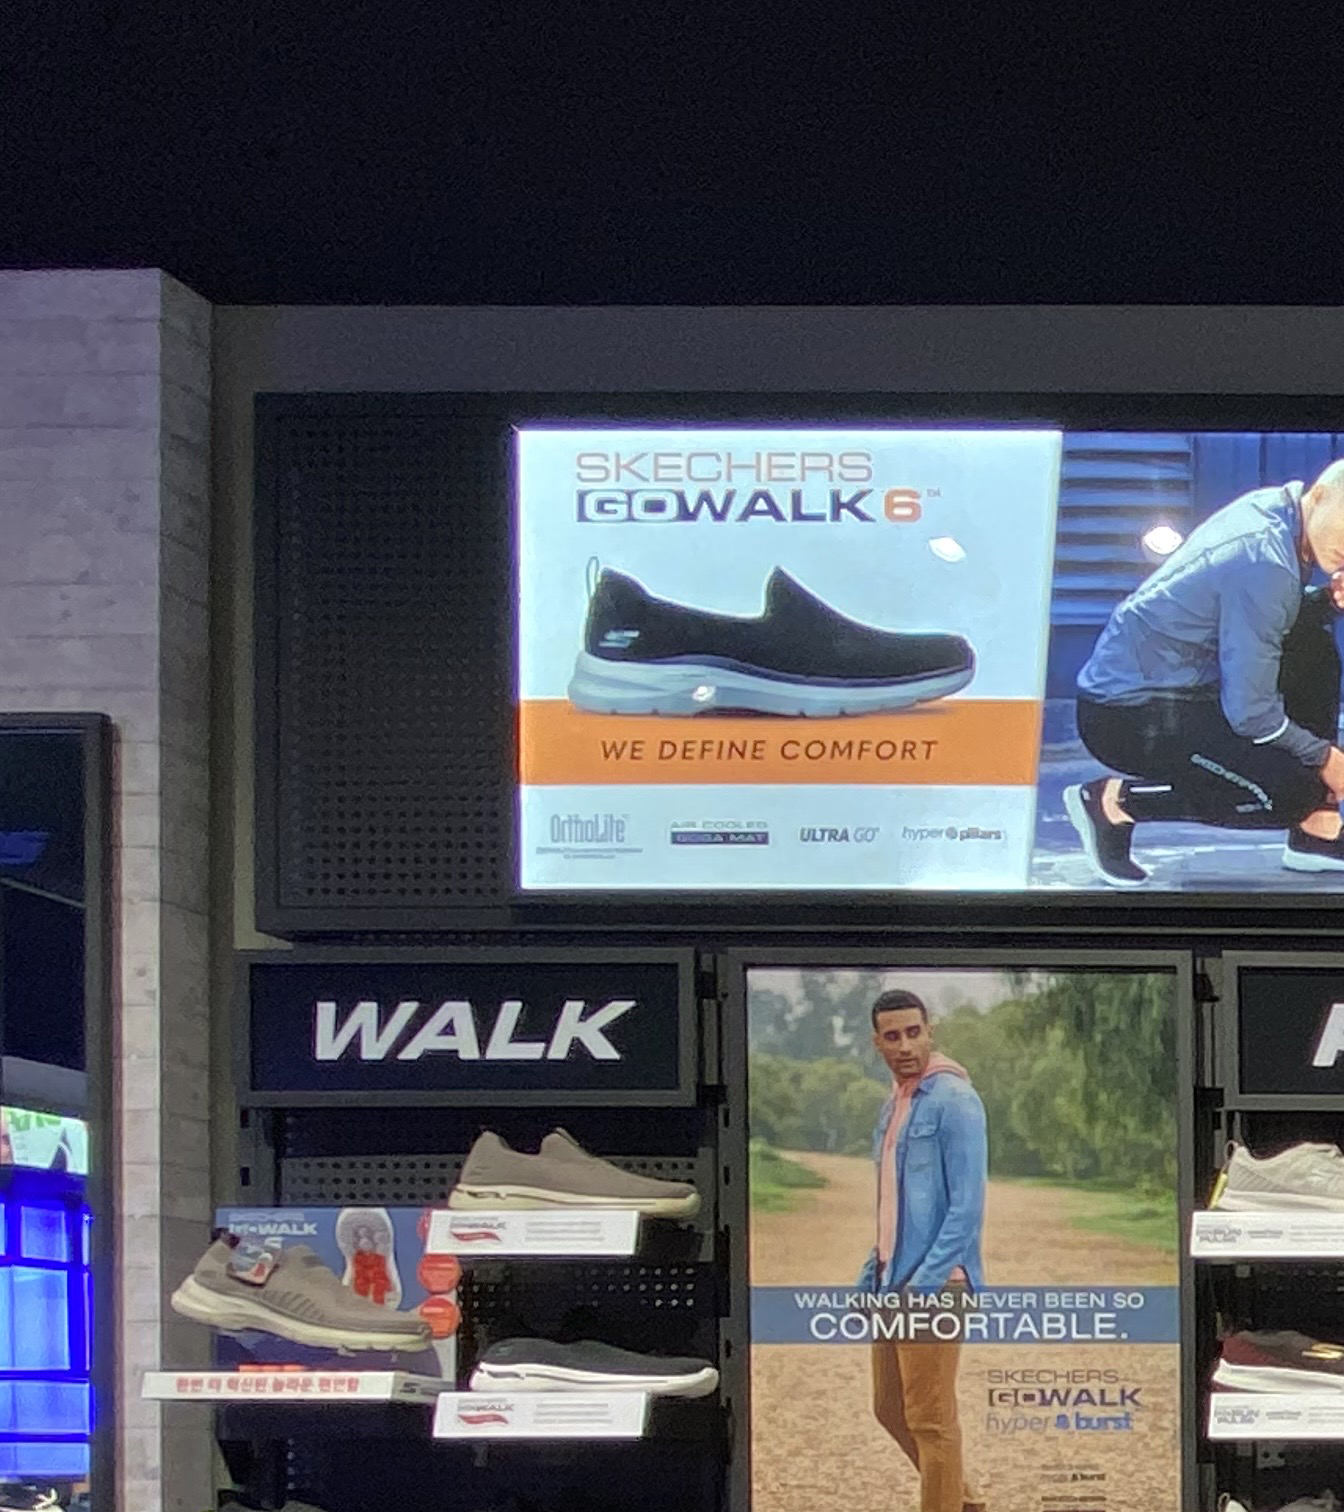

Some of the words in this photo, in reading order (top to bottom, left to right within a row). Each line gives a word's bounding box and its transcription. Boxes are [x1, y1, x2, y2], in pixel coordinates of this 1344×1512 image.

[576, 451, 873, 484] SKECHERS
[576, 488, 876, 523] GOWALK
[601, 739, 645, 761] WE
[658, 739, 768, 761] DEFINE
[780, 739, 939, 761] COMFORT
[800, 827, 850, 843] ULTRA
[902, 826, 943, 842] hyper
[314, 1000, 637, 1061] WALK
[794, 1291, 901, 1310] WALKING
[908, 1291, 955, 1310] HAS
[962, 1291, 1037, 1310] NEVER
[1044, 1291, 1107, 1310] BEEN
[1112, 1291, 1146, 1310] SO
[809, 1312, 1129, 1341] COMFORTABLE.
[987, 1368, 1120, 1385] SKECHERS
[987, 1387, 1143, 1408] GOWALK
[985, 1411, 1050, 1433] hyper
[1074, 1411, 1134, 1431] burst
